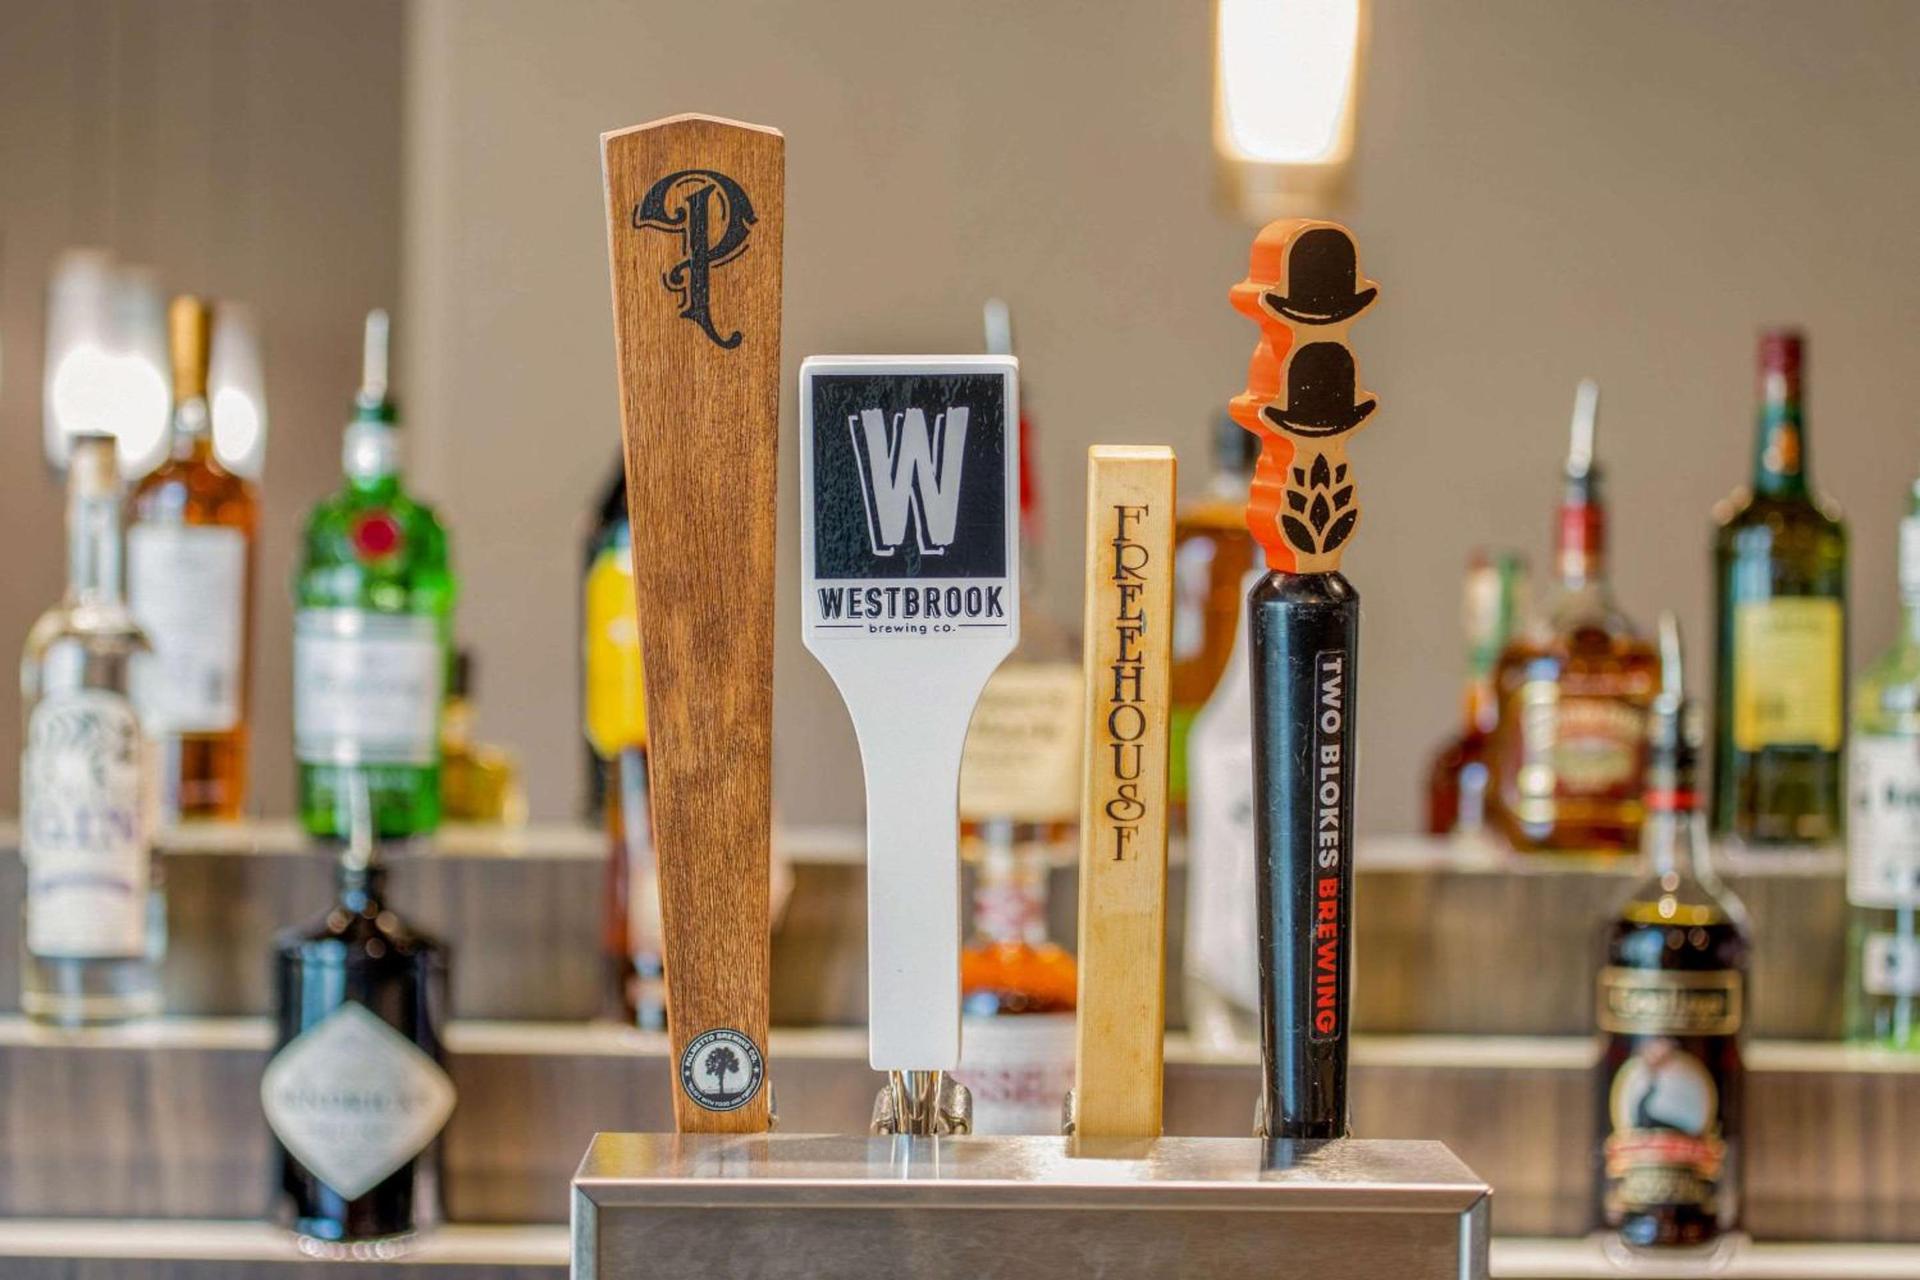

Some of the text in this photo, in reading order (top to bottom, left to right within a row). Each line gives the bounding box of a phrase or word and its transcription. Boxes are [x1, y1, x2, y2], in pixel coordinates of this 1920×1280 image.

[633, 169, 759, 349] P
[848, 406, 970, 556] W
[818, 586, 1005, 620] WESTBROOK
[869, 622, 957, 635] brewing co.
[1315, 657, 1342, 1034] TWO BLOKES BREWING
[686, 1034, 715, 1067] PALMETTO
